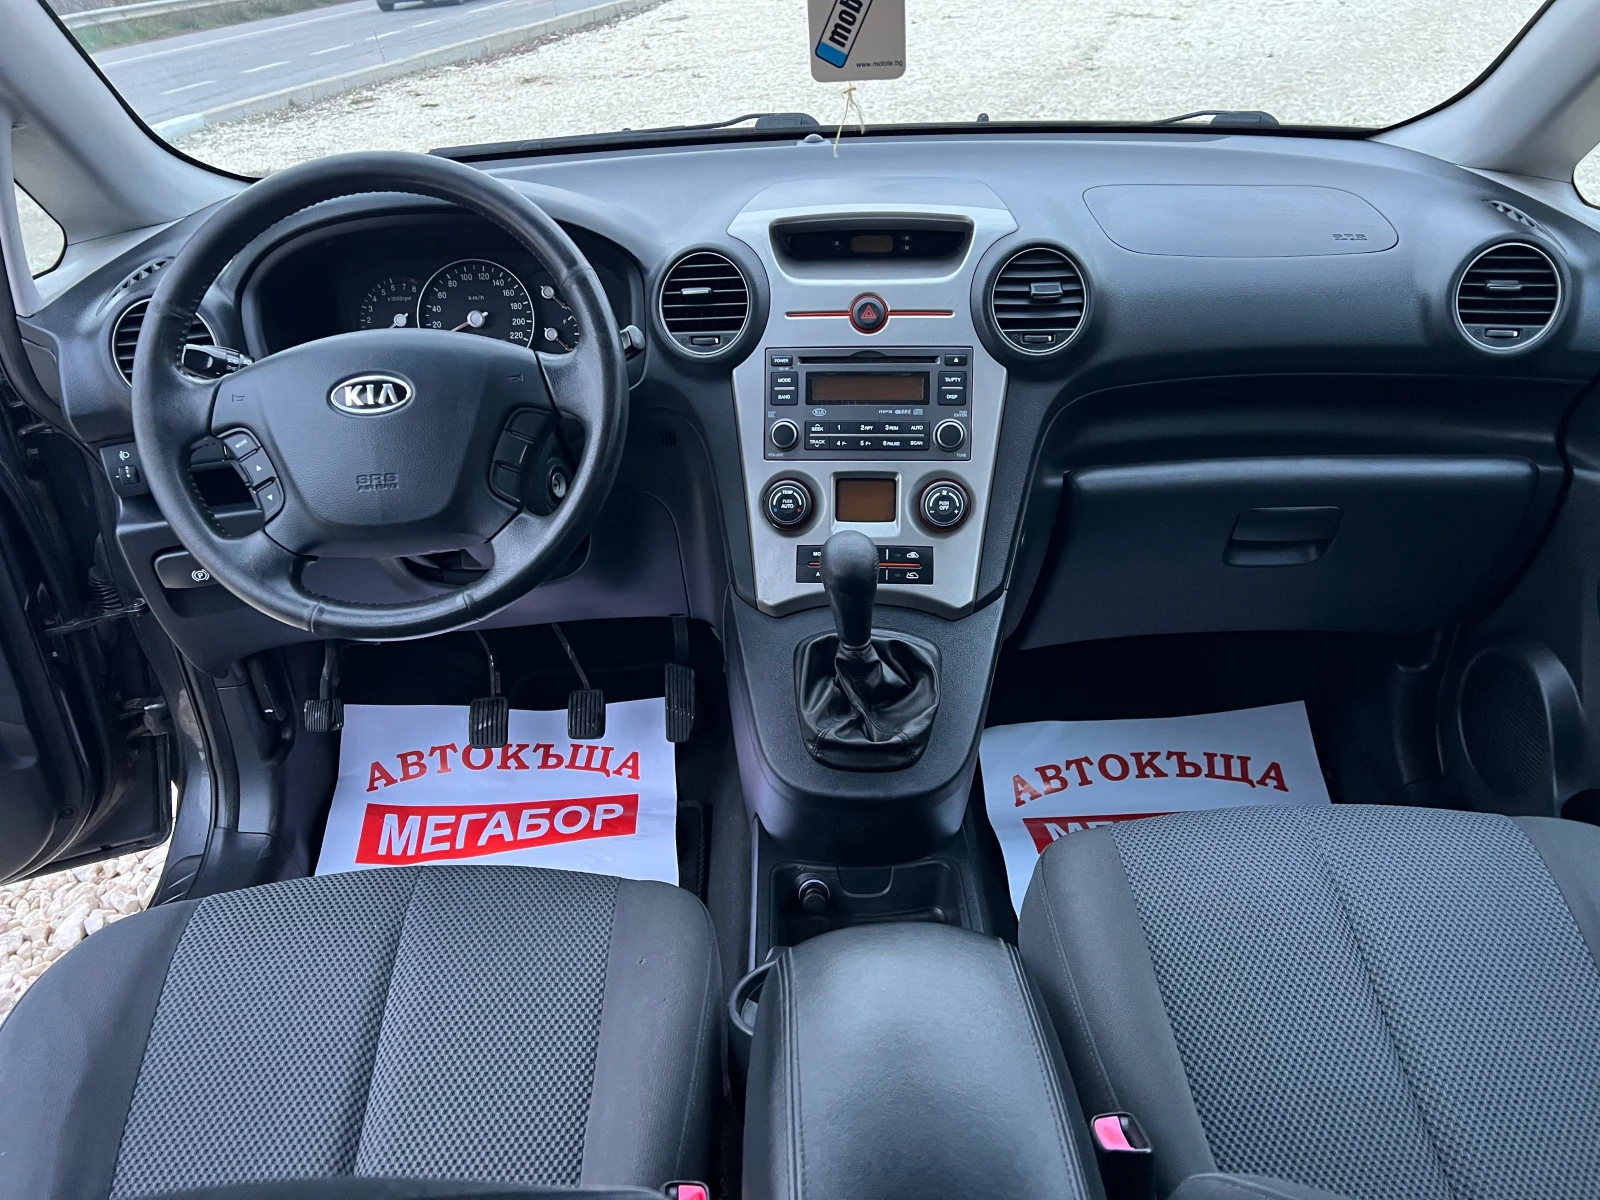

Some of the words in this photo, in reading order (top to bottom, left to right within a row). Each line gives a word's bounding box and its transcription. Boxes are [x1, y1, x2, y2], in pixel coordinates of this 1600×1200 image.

[856, 60, 903, 68] www.mobile.bg
[460, 273, 472, 281] 100
[448, 280, 457, 288] 80
[502, 289, 514, 297] 160
[368, 305, 373, 313] 3
[344, 383, 398, 407] KIA
[356, 472, 398, 484] SRS
[366, 743, 641, 792] АВТОКЪЩА
[1012, 750, 1289, 808] АВТОКЪЩА
[377, 803, 624, 856] МЕГАБОР
